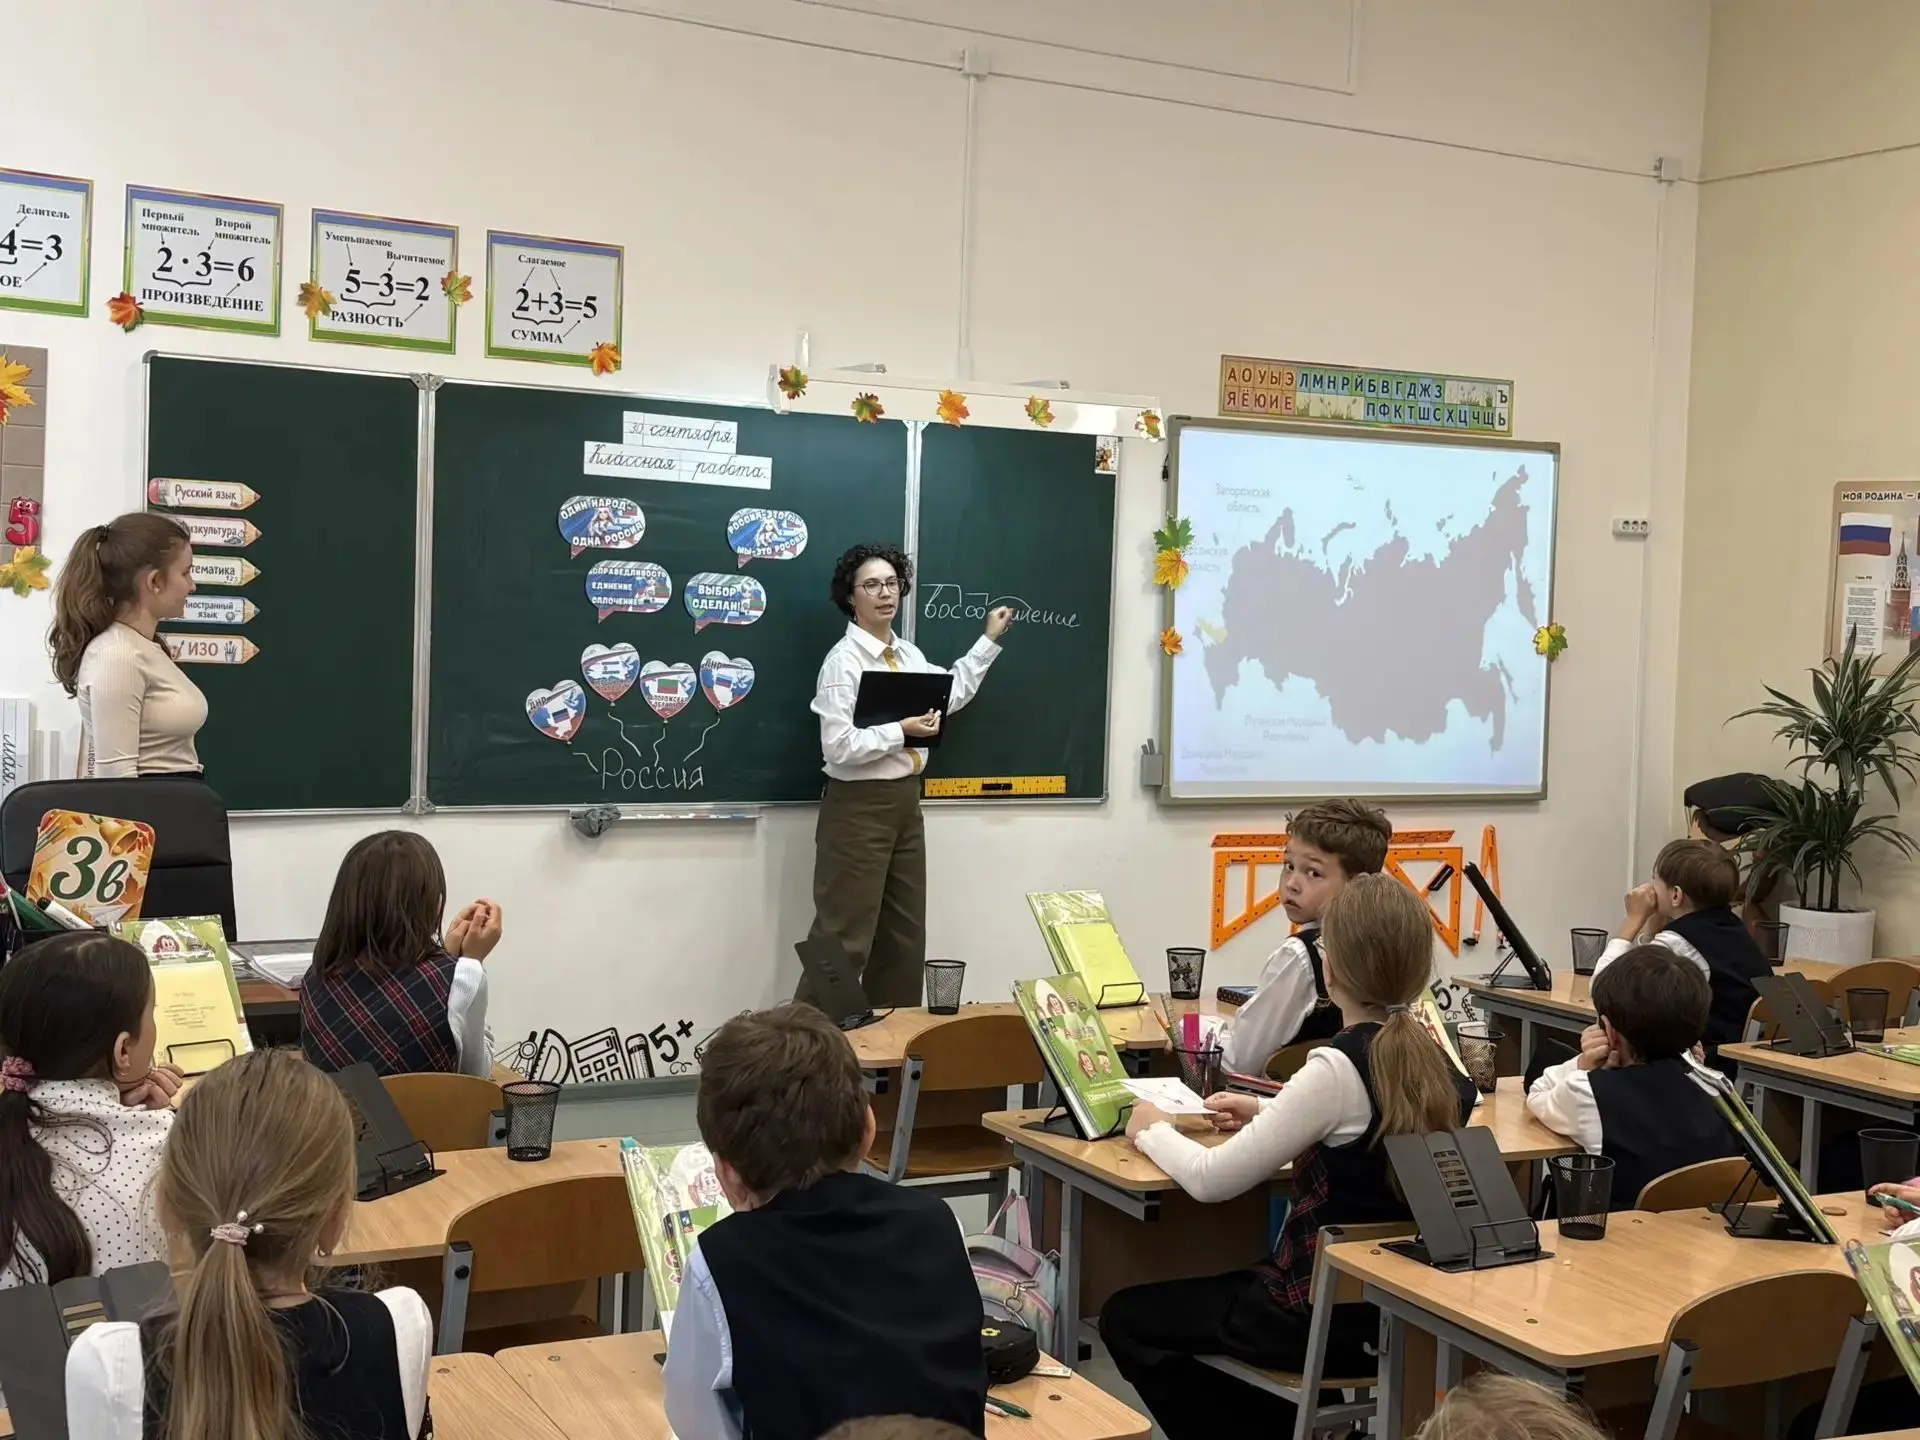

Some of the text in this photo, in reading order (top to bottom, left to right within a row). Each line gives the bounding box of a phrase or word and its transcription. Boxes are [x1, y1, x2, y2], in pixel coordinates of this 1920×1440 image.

[17, 203, 70, 220] Делитель
[142, 207, 185, 222] Первый
[141, 222, 200, 237] множитель
[215, 217, 252, 231] Второй
[215, 231, 272, 245] множитель
[325, 231, 393, 248] Уменьшаемое
[386, 250, 446, 266] Вычитаемое
[518, 253, 567, 268] Слагаемое
[141, 288, 264, 312] ПРОИЗВЕДЕНИЕ
[331, 311, 404, 328] РАЗНОСТЬ
[511, 329, 563, 344] СУММА
[629, 422, 643, 435] 30
[175, 484, 237, 500] Русский язык
[1842, 492, 1862, 501] МОЯ
[1865, 492, 1903, 501] РОДИНА
[561, 500, 590, 520] ОДИН
[189, 525, 237, 539] изкультура
[573, 521, 644, 548] ОДНА РОССИЯ
[774, 532, 806, 552] РОССИЯ
[191, 564, 236, 576] тематика
[591, 582, 633, 592] ЕДИНЕНИЕ
[698, 585, 737, 597] ВЫБОР
[692, 598, 741, 611] СДЕЛАН!
[198, 611, 218, 620] язык
[188, 641, 219, 657] ИЗО
[602, 747, 704, 790] Россия
